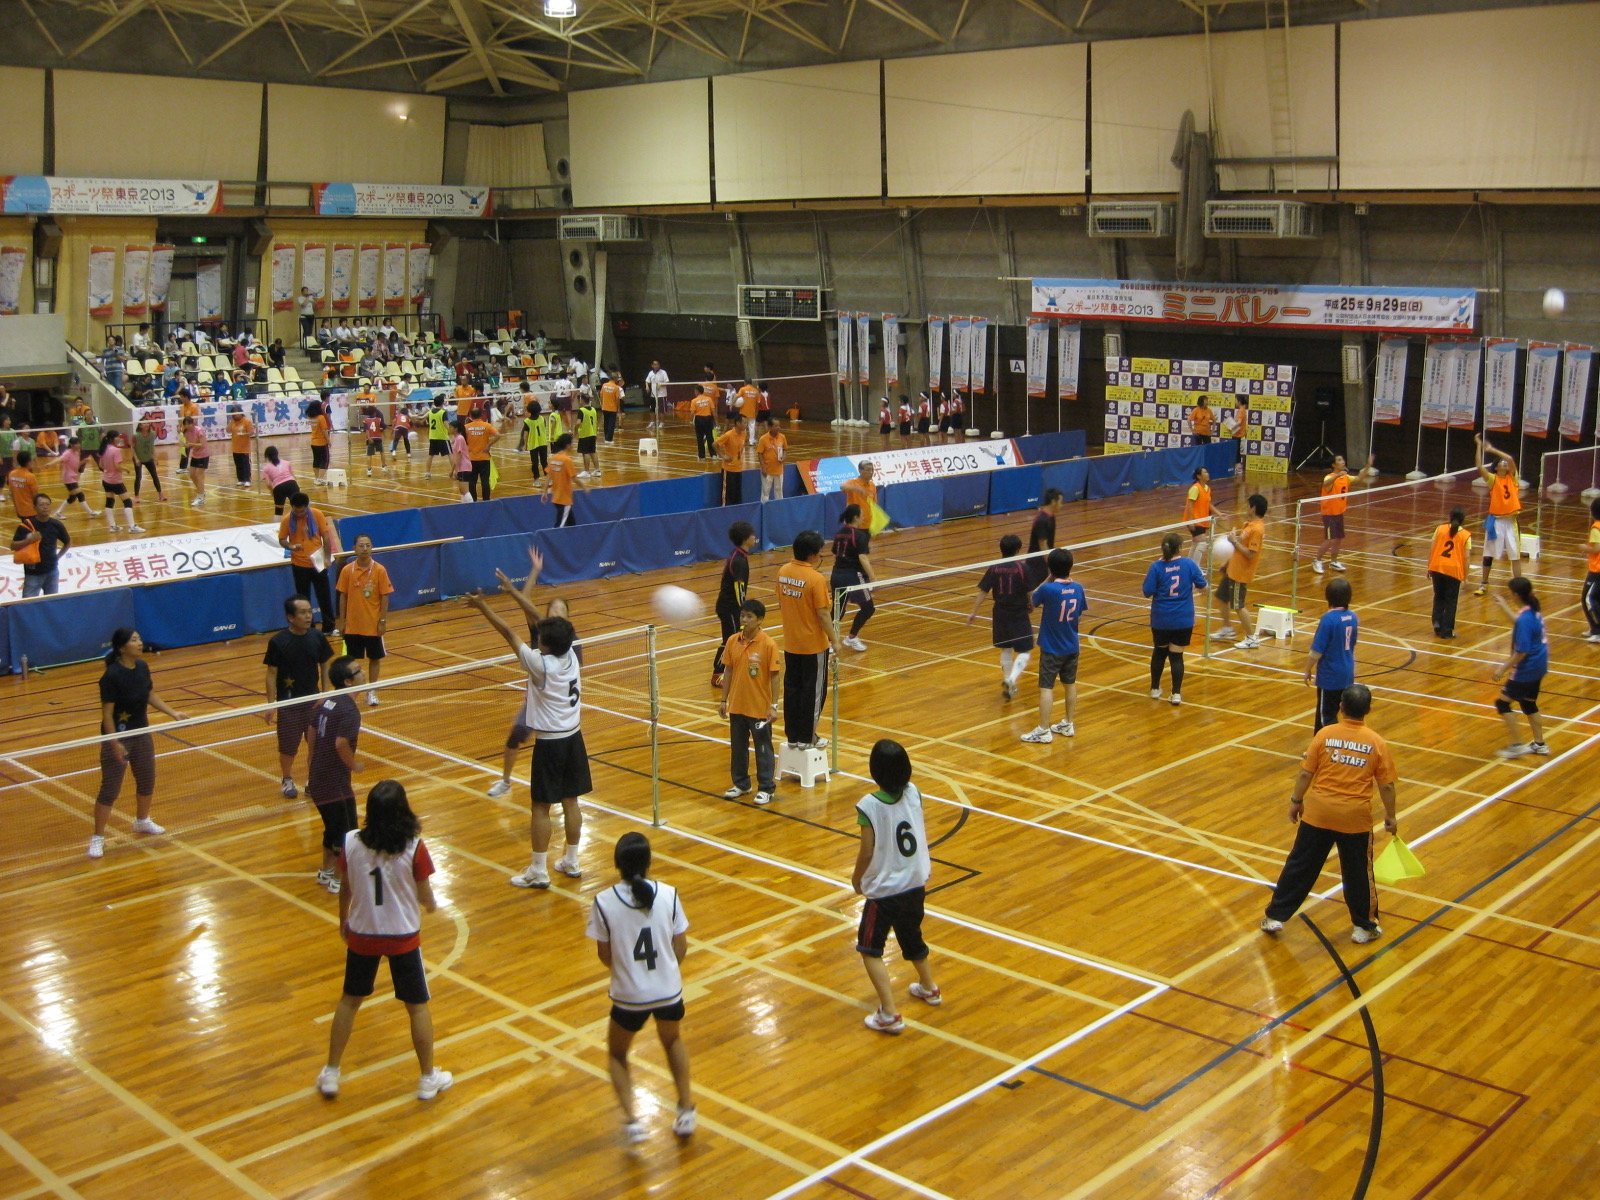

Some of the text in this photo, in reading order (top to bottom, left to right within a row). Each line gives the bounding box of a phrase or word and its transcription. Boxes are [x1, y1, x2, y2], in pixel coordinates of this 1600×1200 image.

[51, 184, 175, 201] スポーツ祭東京2013
[356, 189, 454, 205] スポーツ祭東京2013
[1066, 300, 1154, 316] スポーツ祭東京2013
[1162, 292, 1312, 325] ミニバレー
[1013, 361, 1022, 372] A
[236, 389, 242, 398] 2
[370, 421, 376, 432] 4
[431, 419, 437, 430] 2
[536, 425, 541, 436] 1
[873, 454, 979, 481] ポーツ祭東京2013
[1503, 484, 1511, 500] 3
[1441, 540, 1455, 559] 2
[787, 577, 806, 588] VOLLEY
[1169, 575, 1180, 597] 2
[786, 589, 802, 599] STAFF
[1059, 598, 1077, 622] 12
[213, 623, 237, 632] SAN-EI
[569, 677, 581, 709] 5
[1325, 738, 1373, 755] MINI VOLLEY
[1340, 754, 1367, 768] STAFF
[896, 820, 918, 858] 6
[370, 866, 383, 906] 1
[633, 926, 659, 971] 4
